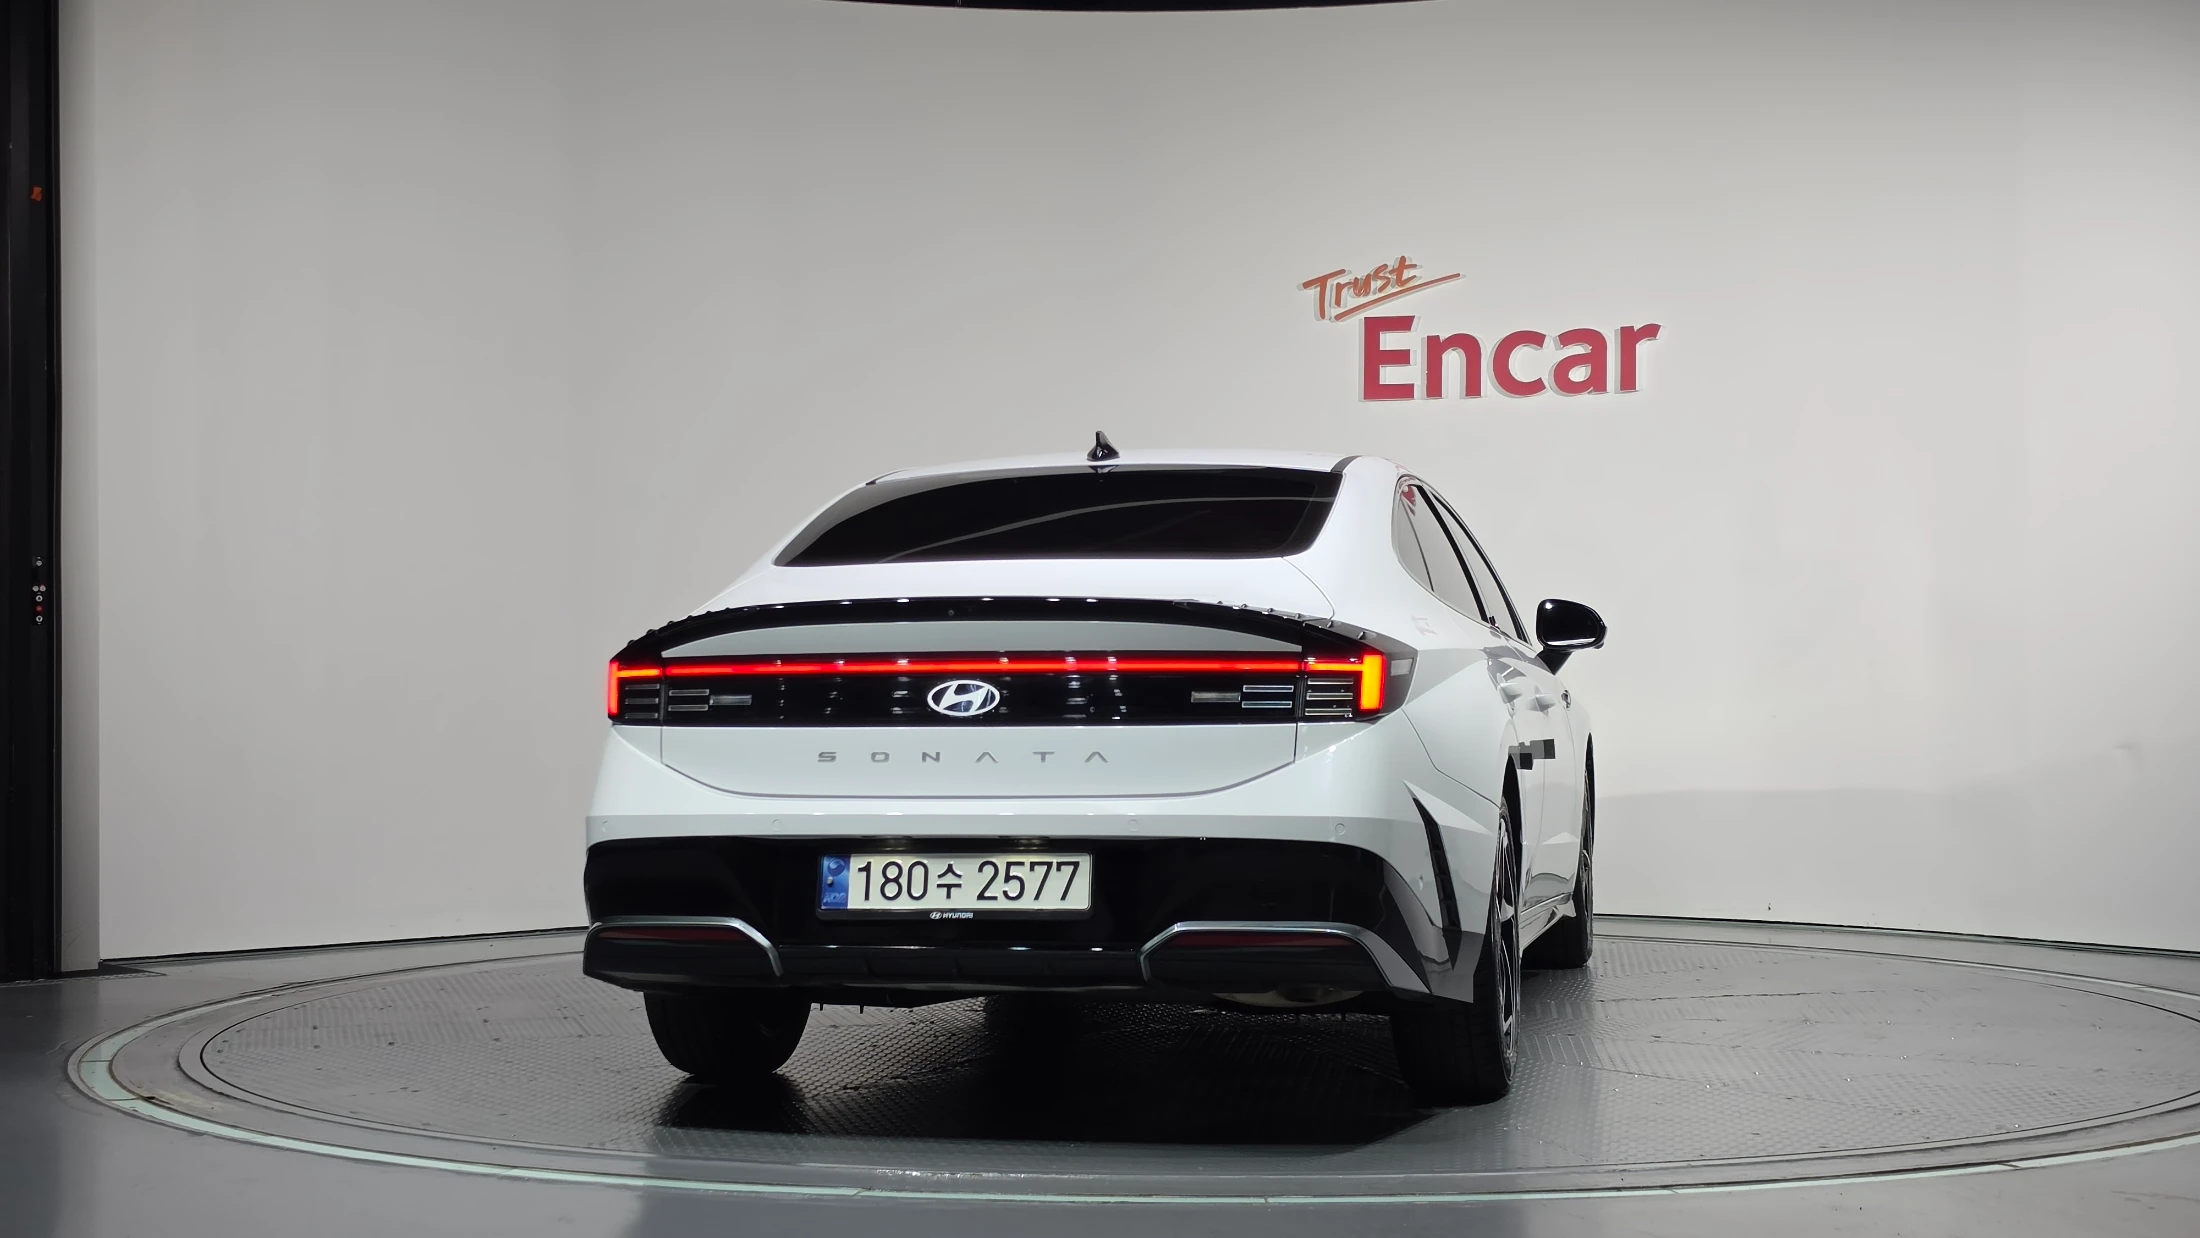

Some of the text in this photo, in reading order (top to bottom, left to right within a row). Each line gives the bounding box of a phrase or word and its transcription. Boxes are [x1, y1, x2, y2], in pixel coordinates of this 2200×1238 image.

[1301, 255, 1419, 320] Trust
[1362, 315, 1662, 401] Encar
[817, 751, 1109, 764] SONATA
[857, 860, 1081, 902] 180수 2577
